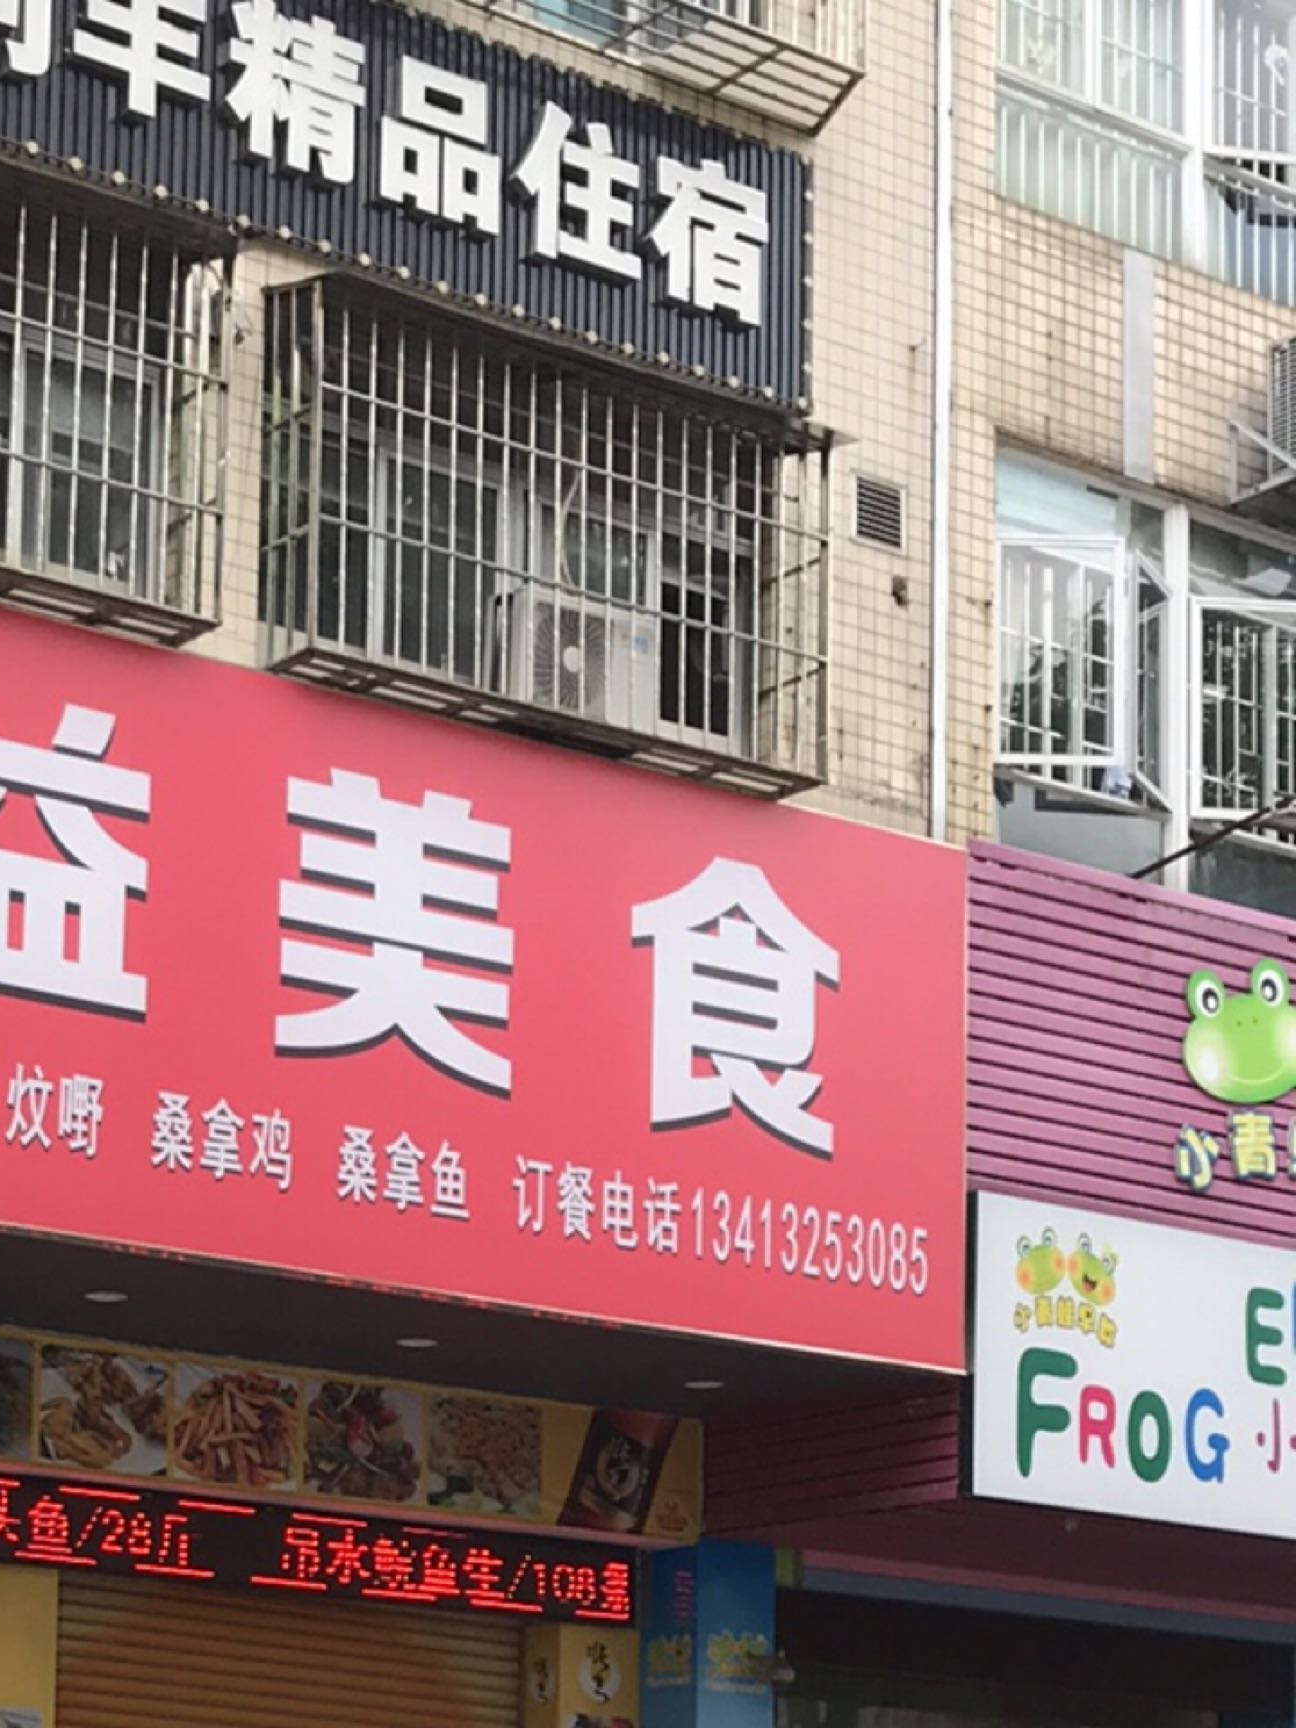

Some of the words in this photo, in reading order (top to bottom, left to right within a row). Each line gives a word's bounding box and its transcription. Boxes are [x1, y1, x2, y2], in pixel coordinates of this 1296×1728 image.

[150, 1091, 292, 1193] 桑拿鸡
[336, 1125, 470, 1221] 桑拿鱼
[512, 1154, 929, 1296] 订餐电话13413253085
[1173, 1109, 1296, 1193] 小青
[1246, 1287, 1296, 1386] E
[1017, 1346, 1230, 1484] FROG
